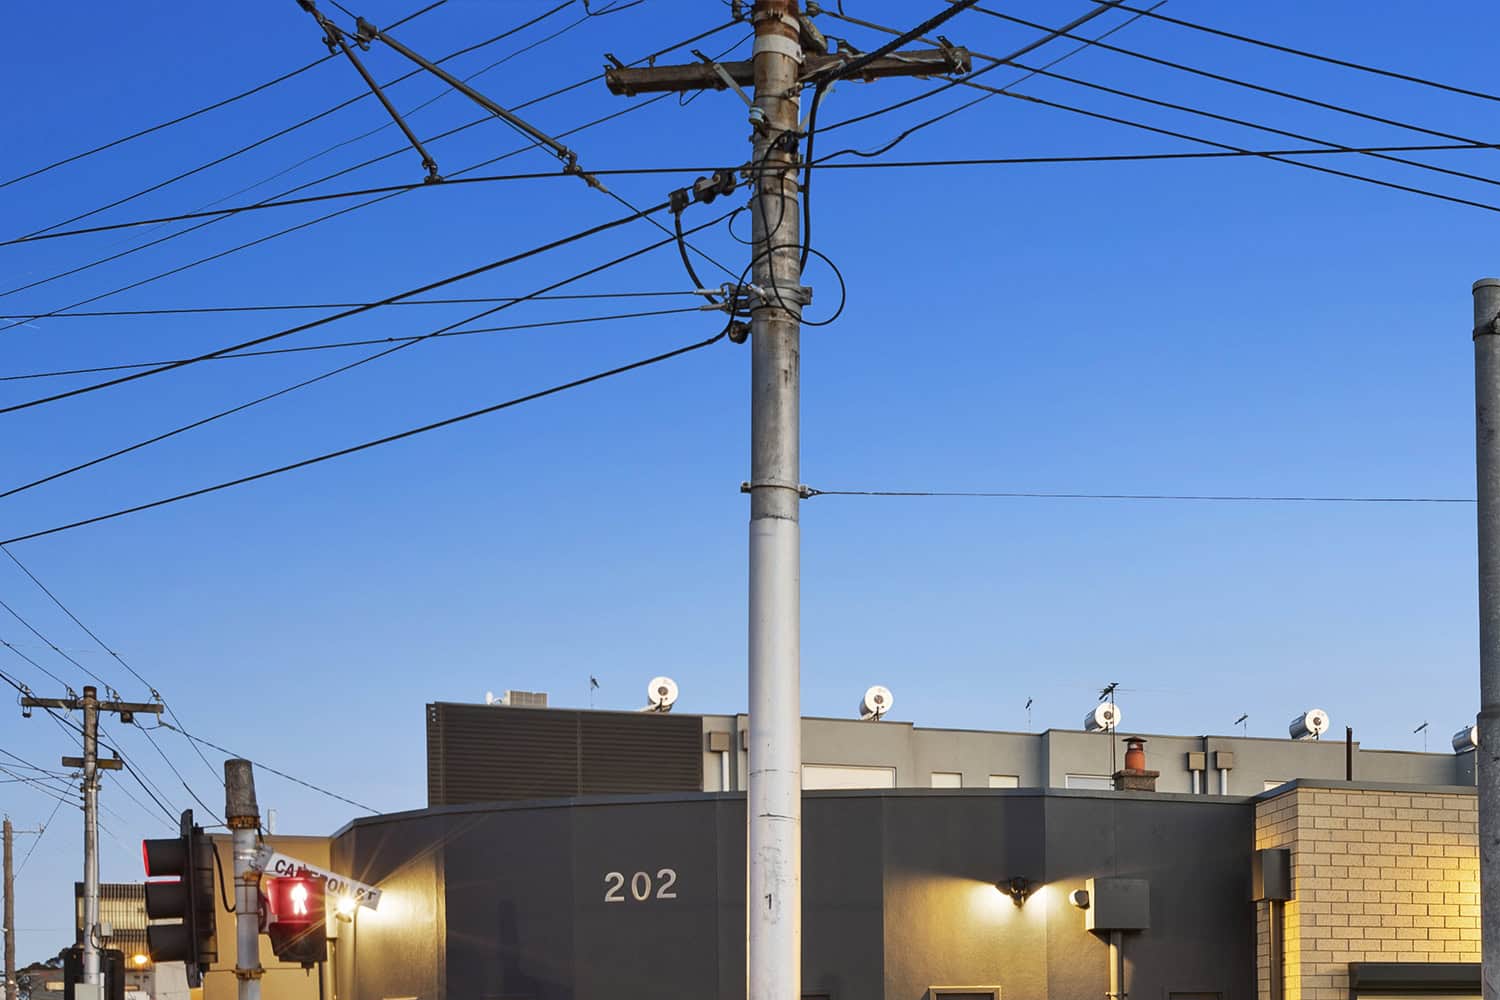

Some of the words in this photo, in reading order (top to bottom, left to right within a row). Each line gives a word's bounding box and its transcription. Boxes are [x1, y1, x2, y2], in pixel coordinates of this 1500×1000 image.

[275, 860, 348, 894] CAON
[356, 887, 377, 902] ST
[604, 868, 677, 902] 202
